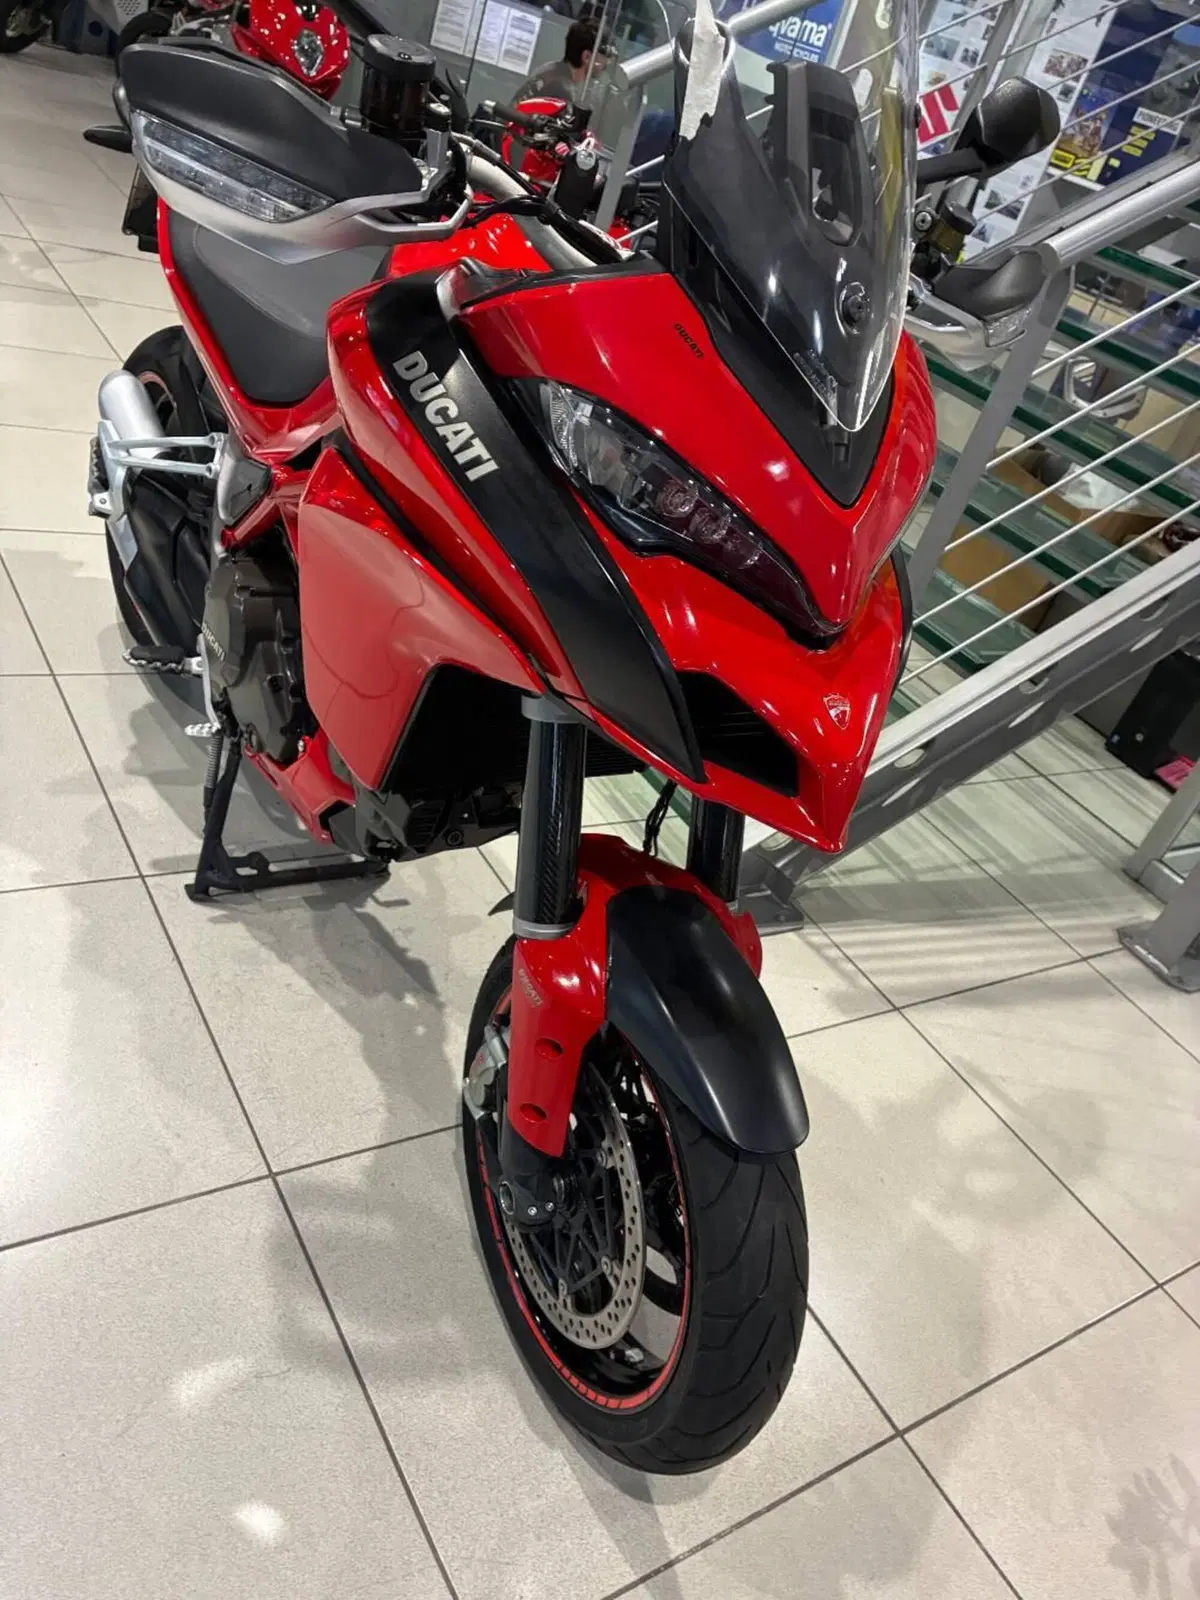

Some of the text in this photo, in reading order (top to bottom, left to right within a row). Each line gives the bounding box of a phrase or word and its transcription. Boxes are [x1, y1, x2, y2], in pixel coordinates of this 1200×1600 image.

[673, 323, 704, 359] DUCATI
[392, 350, 500, 482] DUCATI
[201, 621, 226, 662] DUCATI
